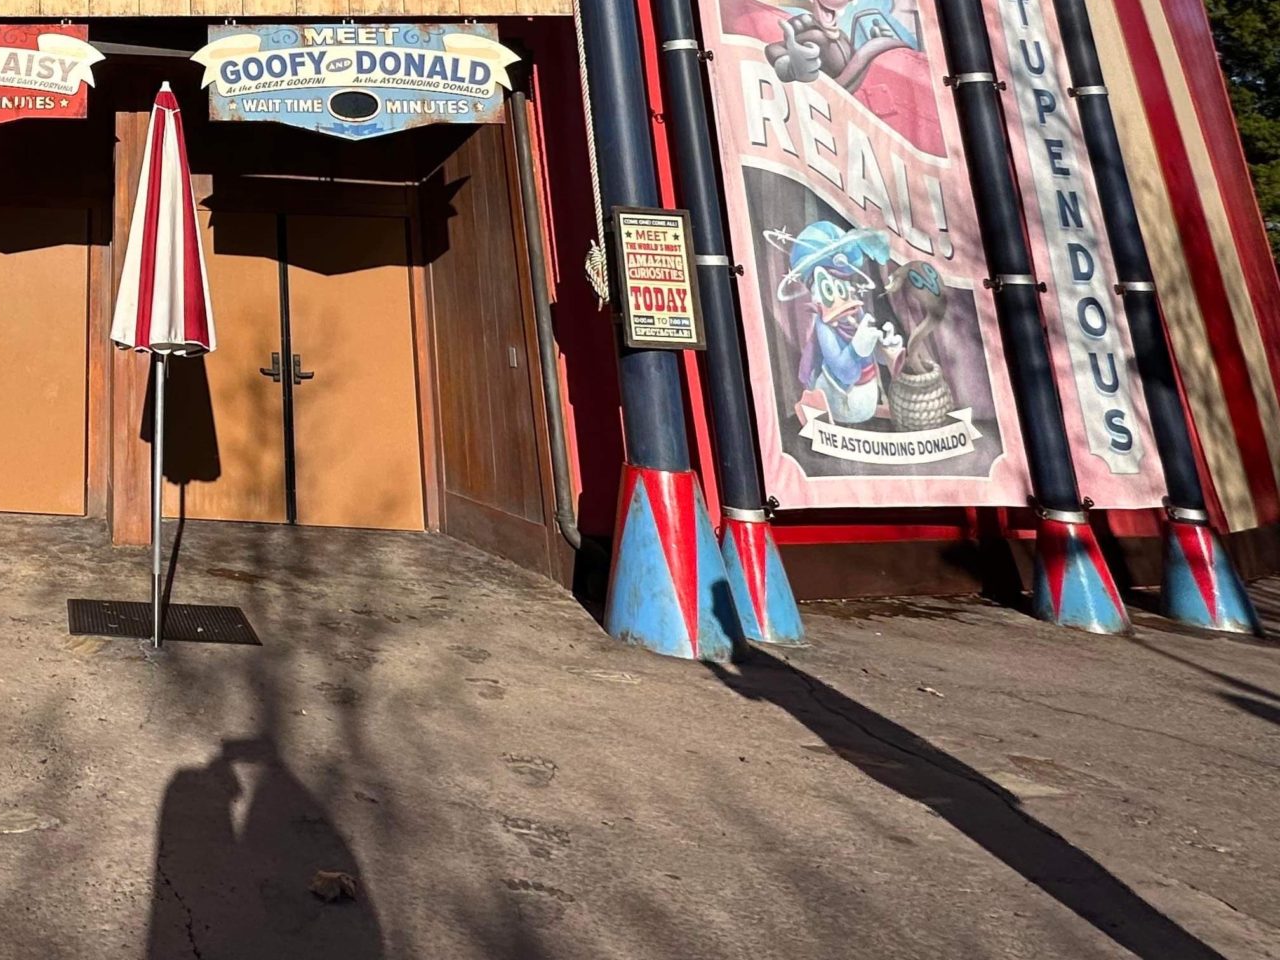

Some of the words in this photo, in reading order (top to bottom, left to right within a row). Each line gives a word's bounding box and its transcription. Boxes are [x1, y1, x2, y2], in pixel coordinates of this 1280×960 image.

[305, 27, 399, 45] MEET
[220, 51, 327, 84] GOOFY
[327, 60, 351, 70] AND
[356, 51, 491, 86] DONALD
[16, 77, 38, 86] DAISY
[255, 80, 285, 90] GREAT
[286, 76, 326, 86] GOOFINI
[379, 77, 440, 90] ASTOUNDING
[441, 82, 489, 96] DONALDO
[242, 99, 280, 113] WAIT
[284, 99, 323, 113] TIME
[385, 100, 469, 114] MINUTES
[740, 58, 956, 260] REAL!
[635, 230, 668, 241] MEET
[626, 242, 636, 250] THE
[628, 254, 683, 270] AMAZING
[629, 267, 685, 281] CURIOSITIES
[630, 286, 687, 313] TODAY
[657, 317, 668, 325] TO
[819, 430, 838, 448] THE
[841, 436, 916, 456] ASTOUNDING
[918, 433, 966, 455] DONALDO
